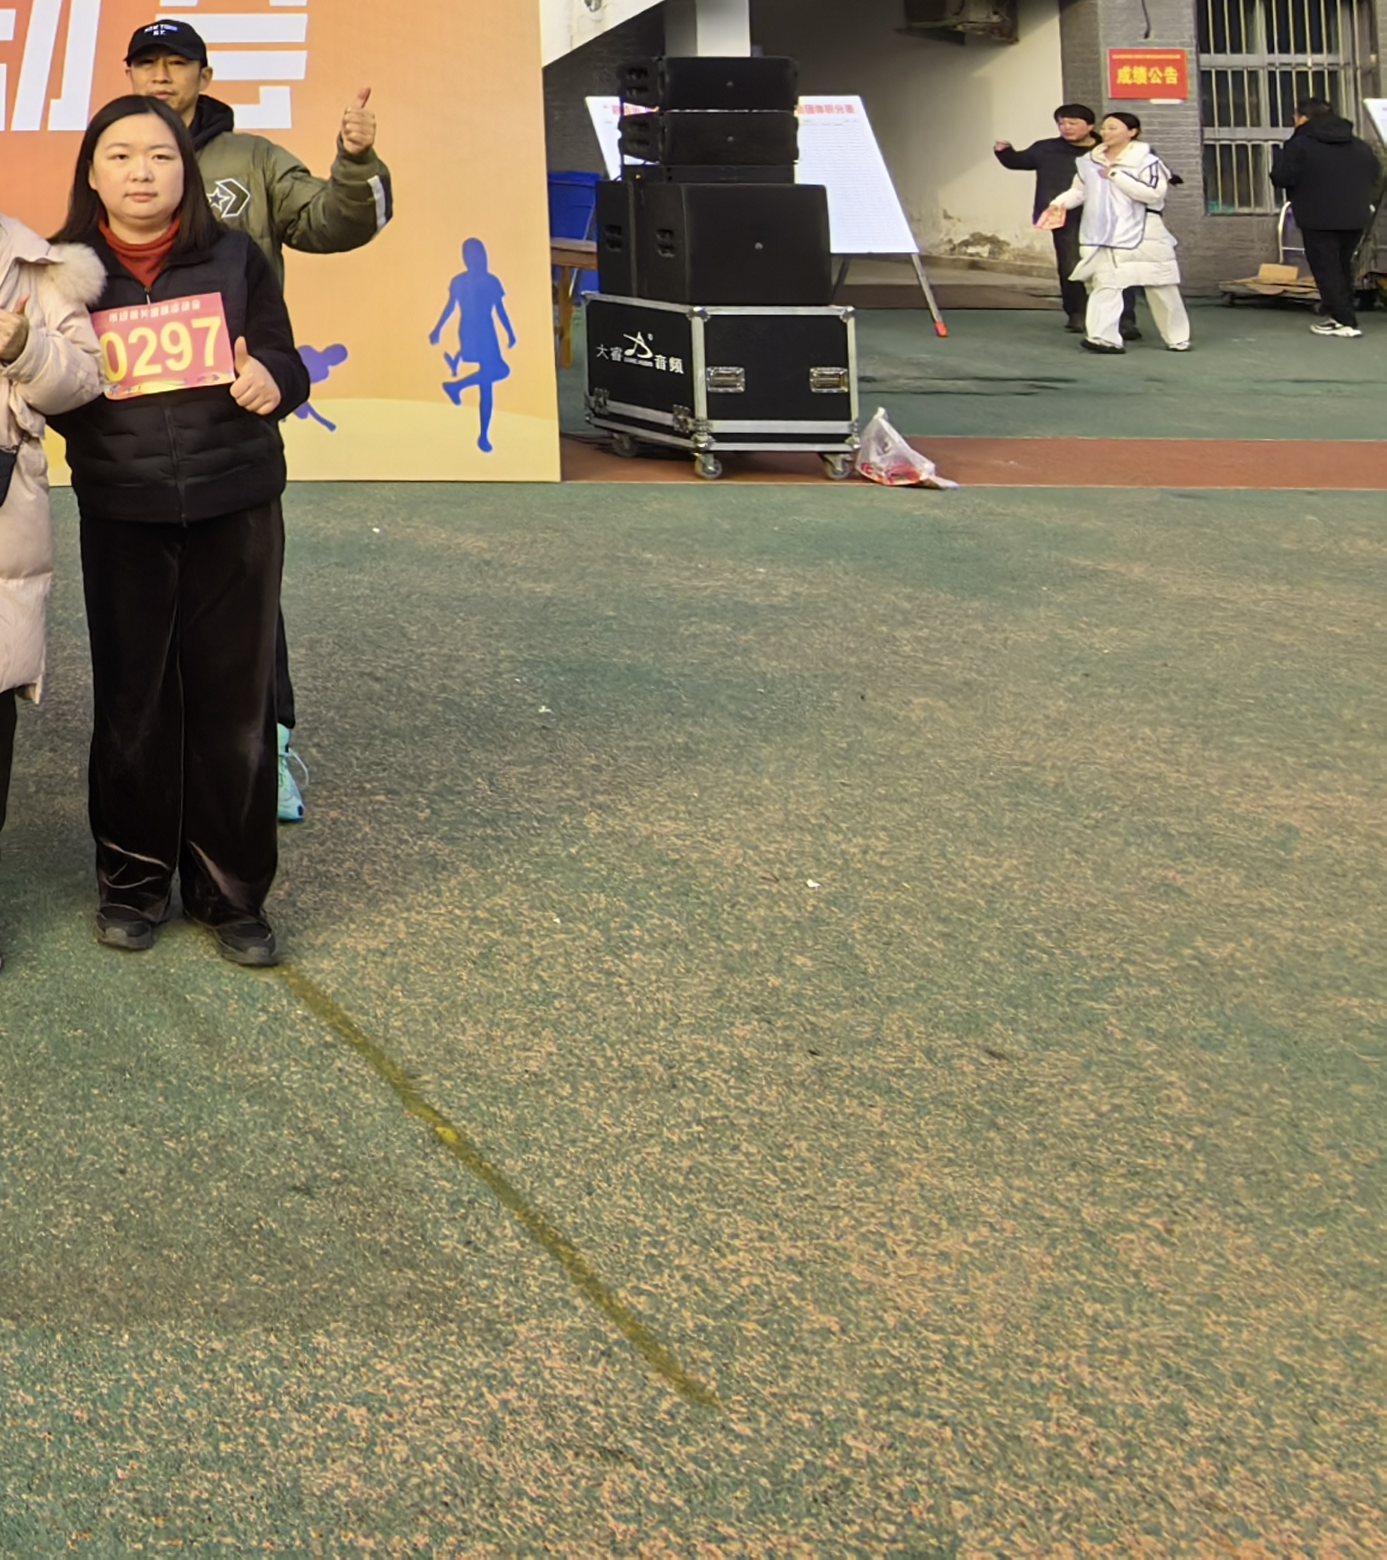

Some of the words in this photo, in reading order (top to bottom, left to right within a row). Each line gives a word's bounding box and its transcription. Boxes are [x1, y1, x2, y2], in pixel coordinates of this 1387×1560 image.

[1116, 65, 1179, 85] 成绩公告
[99, 315, 222, 384] 0297
